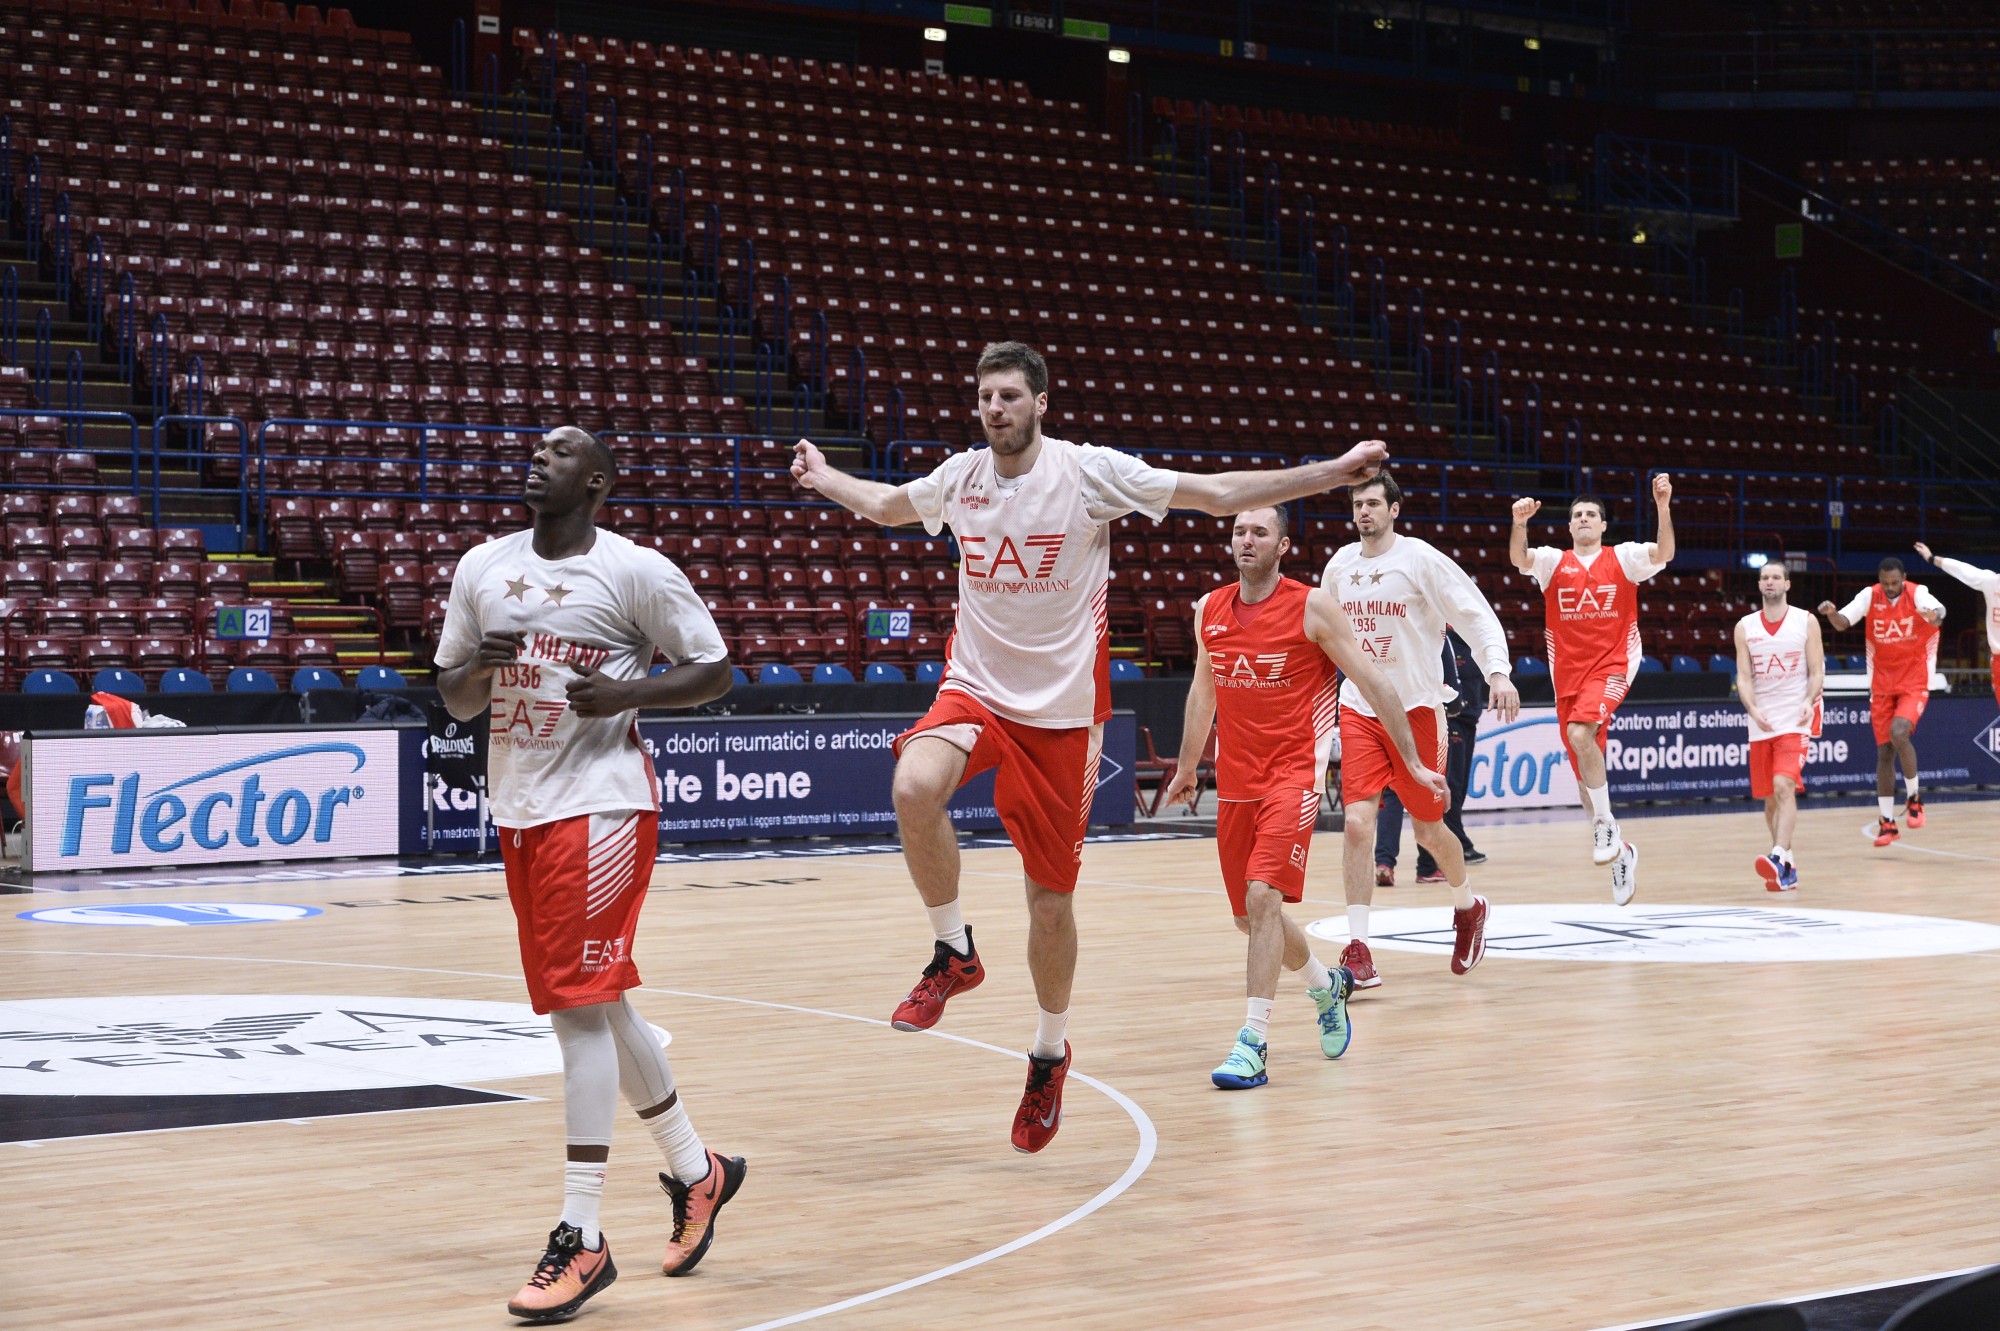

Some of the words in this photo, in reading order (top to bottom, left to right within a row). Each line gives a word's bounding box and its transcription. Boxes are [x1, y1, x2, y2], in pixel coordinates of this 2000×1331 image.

[1023, 15, 1047, 29] BAR
[960, 533, 1066, 578] EA7
[968, 579, 1006, 594] EMPORIO
[1022, 579, 1070, 594] ARMANI
[1558, 584, 1617, 612] EA7
[1342, 600, 1364, 616] MPIA
[1367, 600, 1407, 618] MILANO
[223, 613, 239, 631] A
[248, 613, 267, 631] 21
[872, 616, 885, 631] A
[892, 616, 907, 632] 22
[1353, 617, 1376, 632] 1936
[1873, 616, 1914, 638] EA7
[530, 632, 610, 669] MILANO
[1360, 635, 1393, 657] A7
[1208, 651, 1289, 680] EA7
[1750, 651, 1802, 674] EA7
[499, 663, 541, 690] 1936
[1655, 711, 1681, 729] mal
[1683, 710, 1697, 728] di
[1823, 706, 1848, 724] atici
[1849, 711, 1858, 724] e
[430, 735, 475, 754] SPALDING
[666, 732, 719, 754] dolori
[725, 730, 809, 752] reumatici
[814, 733, 826, 750] e
[831, 728, 905, 750] articola
[1807, 739, 1849, 764] ene
[716, 759, 811, 801] bene
[1466, 741, 1561, 798] ctor
[659, 817, 701, 831] ndesiderati
[702, 817, 726, 829] anche
[749, 815, 781, 829] Leggere
[965, 807, 998, 819] 5/11/201
[443, 826, 488, 839] medicina
[582, 934, 627, 965] EA7
[0, 1025, 554, 1073] YEWEAR
